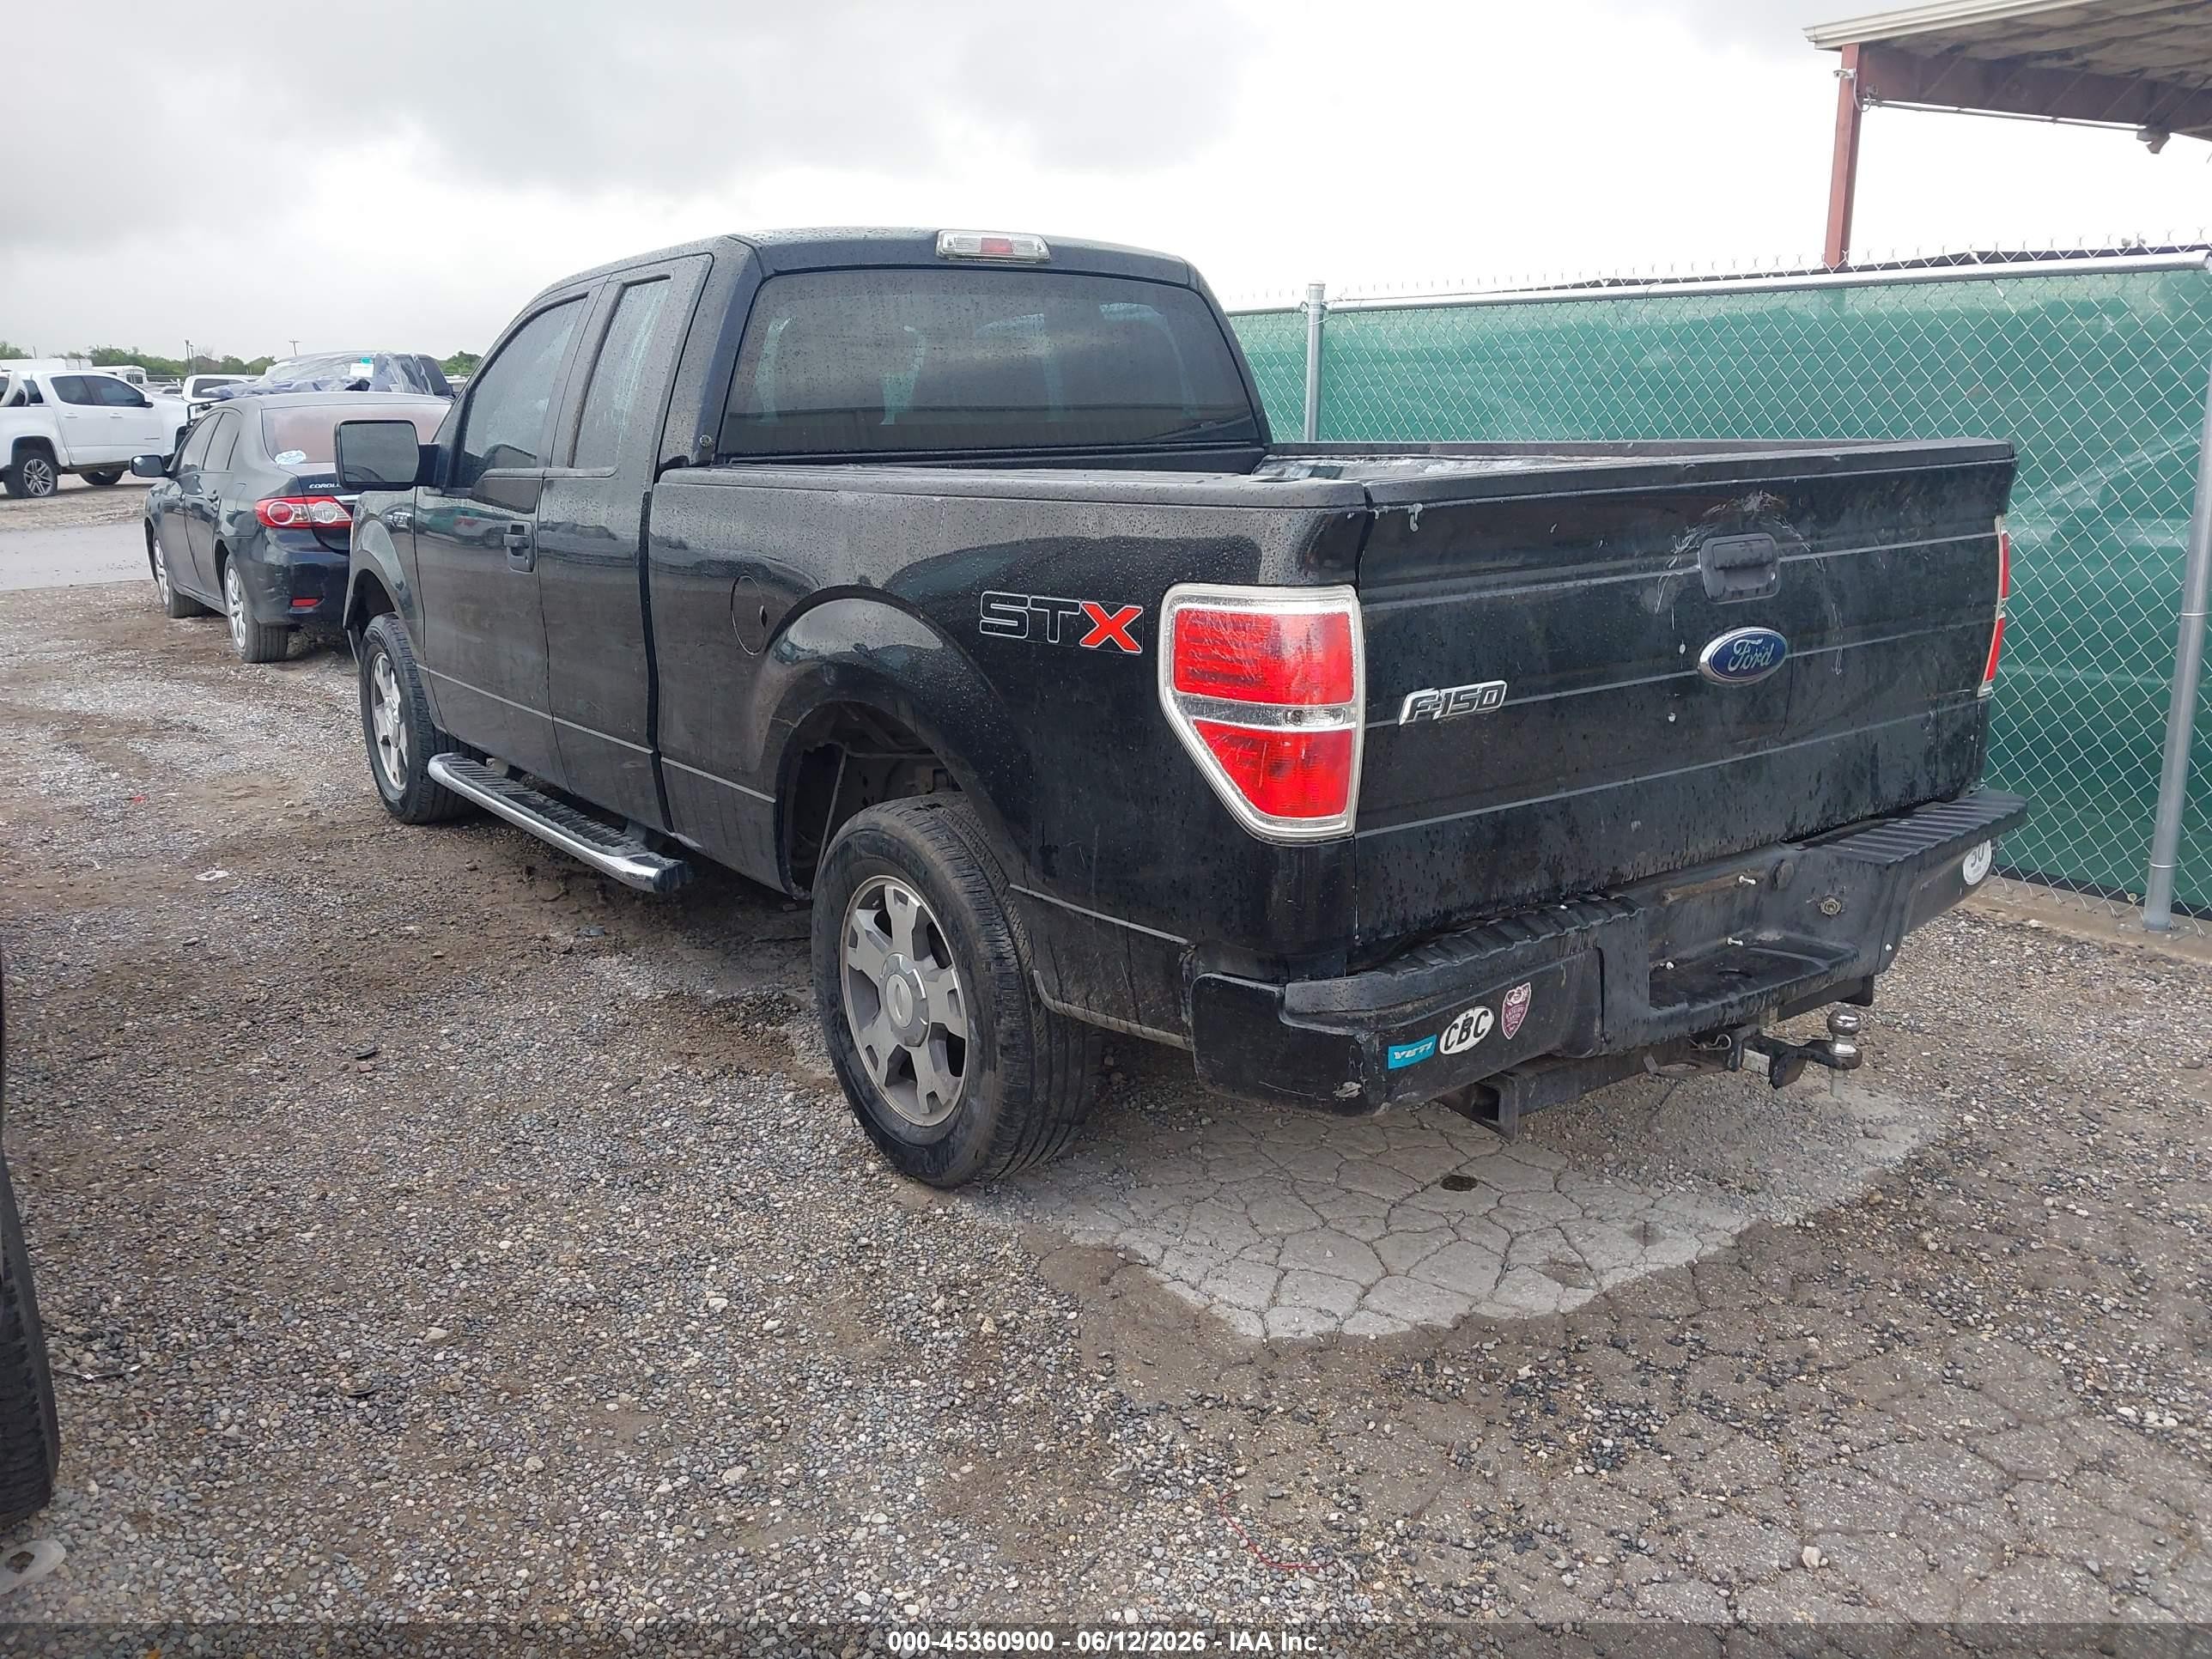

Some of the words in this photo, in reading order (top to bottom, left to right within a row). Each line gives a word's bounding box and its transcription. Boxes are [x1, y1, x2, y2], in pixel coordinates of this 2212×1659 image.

[979, 590, 1145, 654] STX
[1728, 638, 1775, 672] Ford
[1398, 679, 1508, 726] F-150
[1443, 1010, 1490, 1051] CBC
